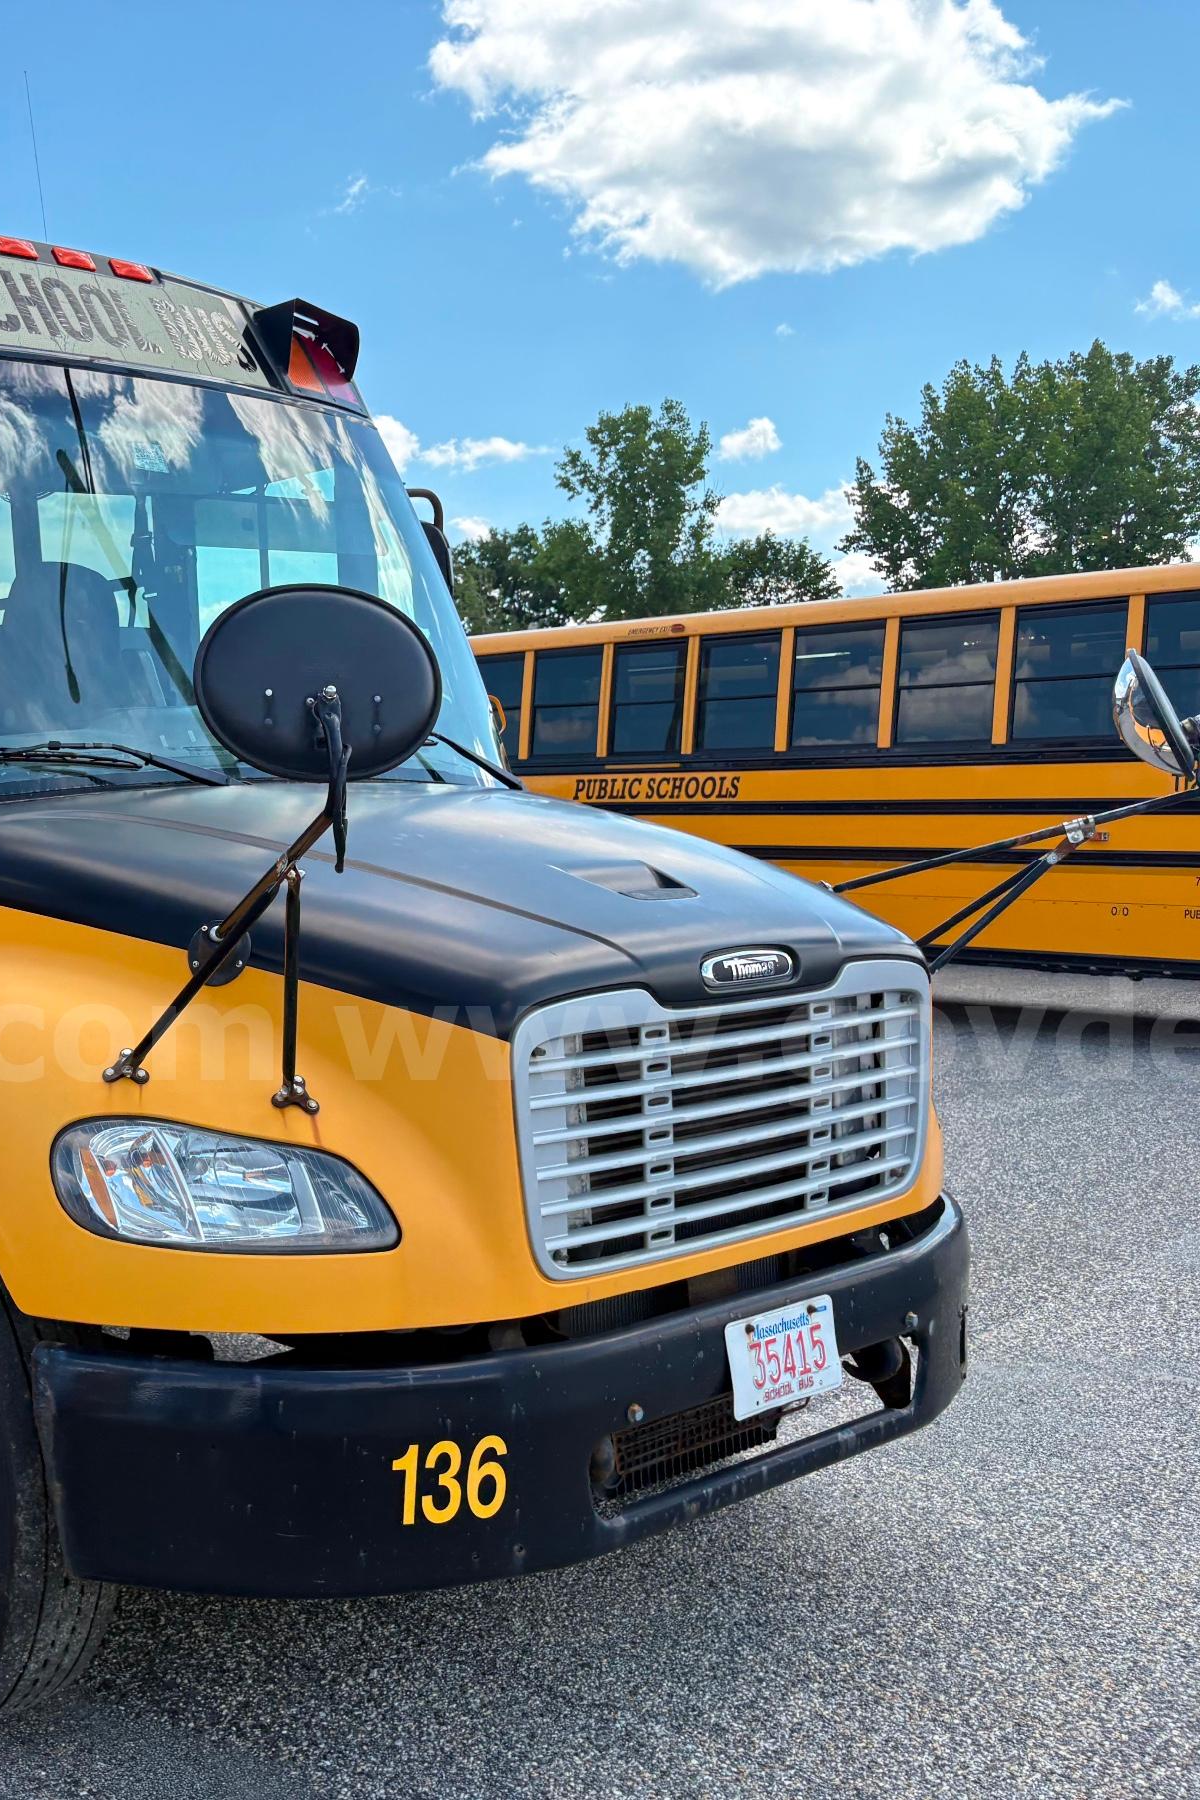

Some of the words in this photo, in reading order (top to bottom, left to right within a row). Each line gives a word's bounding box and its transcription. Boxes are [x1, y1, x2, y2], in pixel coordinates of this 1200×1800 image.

[151, 297, 258, 373] BUS
[627, 626, 659, 636] EMERGENCY
[572, 777, 642, 801] PUBLIC
[645, 775, 741, 800] SCHOOLS
[722, 954, 779, 981] Thomas
[753, 1311, 810, 1341] Massachusetts
[748, 1322, 828, 1391] 35415
[764, 1380, 794, 1403] SCHOOL
[797, 1375, 815, 1393] BUS
[391, 1434, 508, 1526] 136
